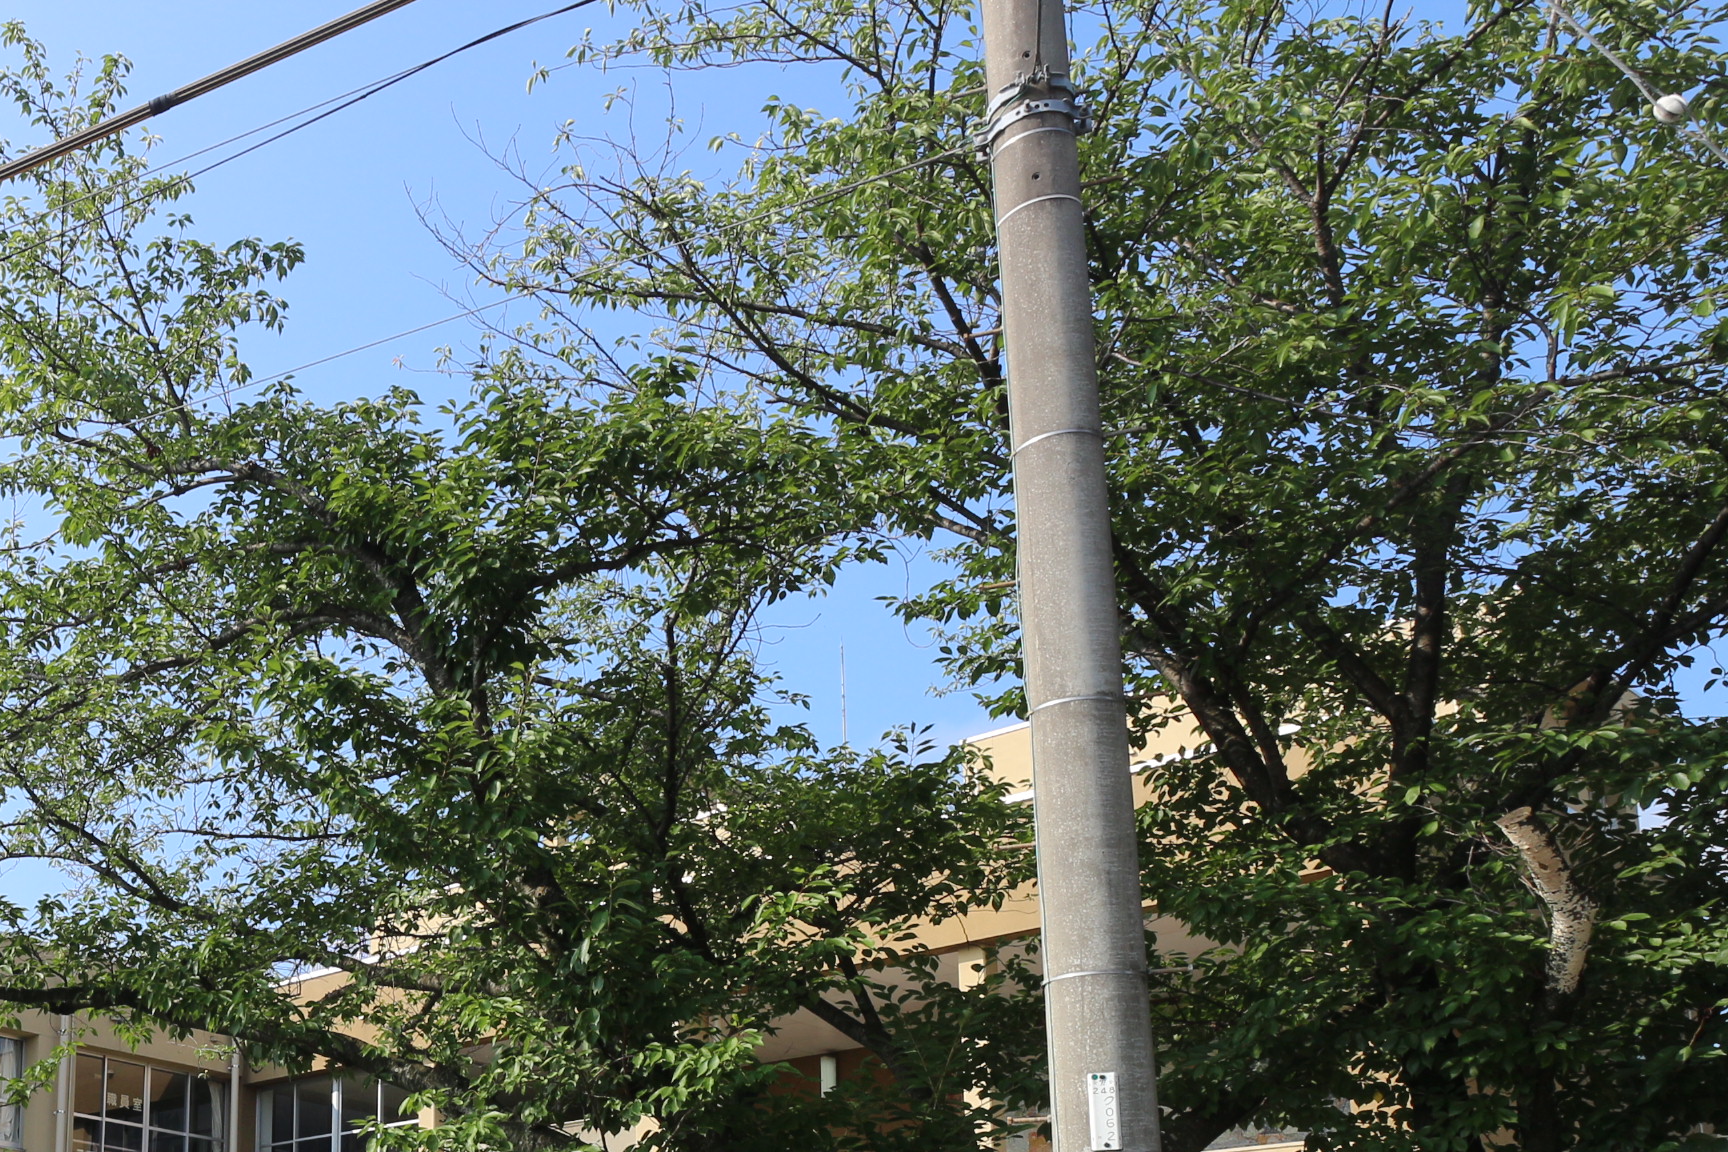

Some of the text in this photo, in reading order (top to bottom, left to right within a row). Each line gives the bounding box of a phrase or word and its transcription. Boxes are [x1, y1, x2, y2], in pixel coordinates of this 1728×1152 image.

[1092, 1086, 1115, 1095] 248
[107, 1091, 143, 1112] 職員室
